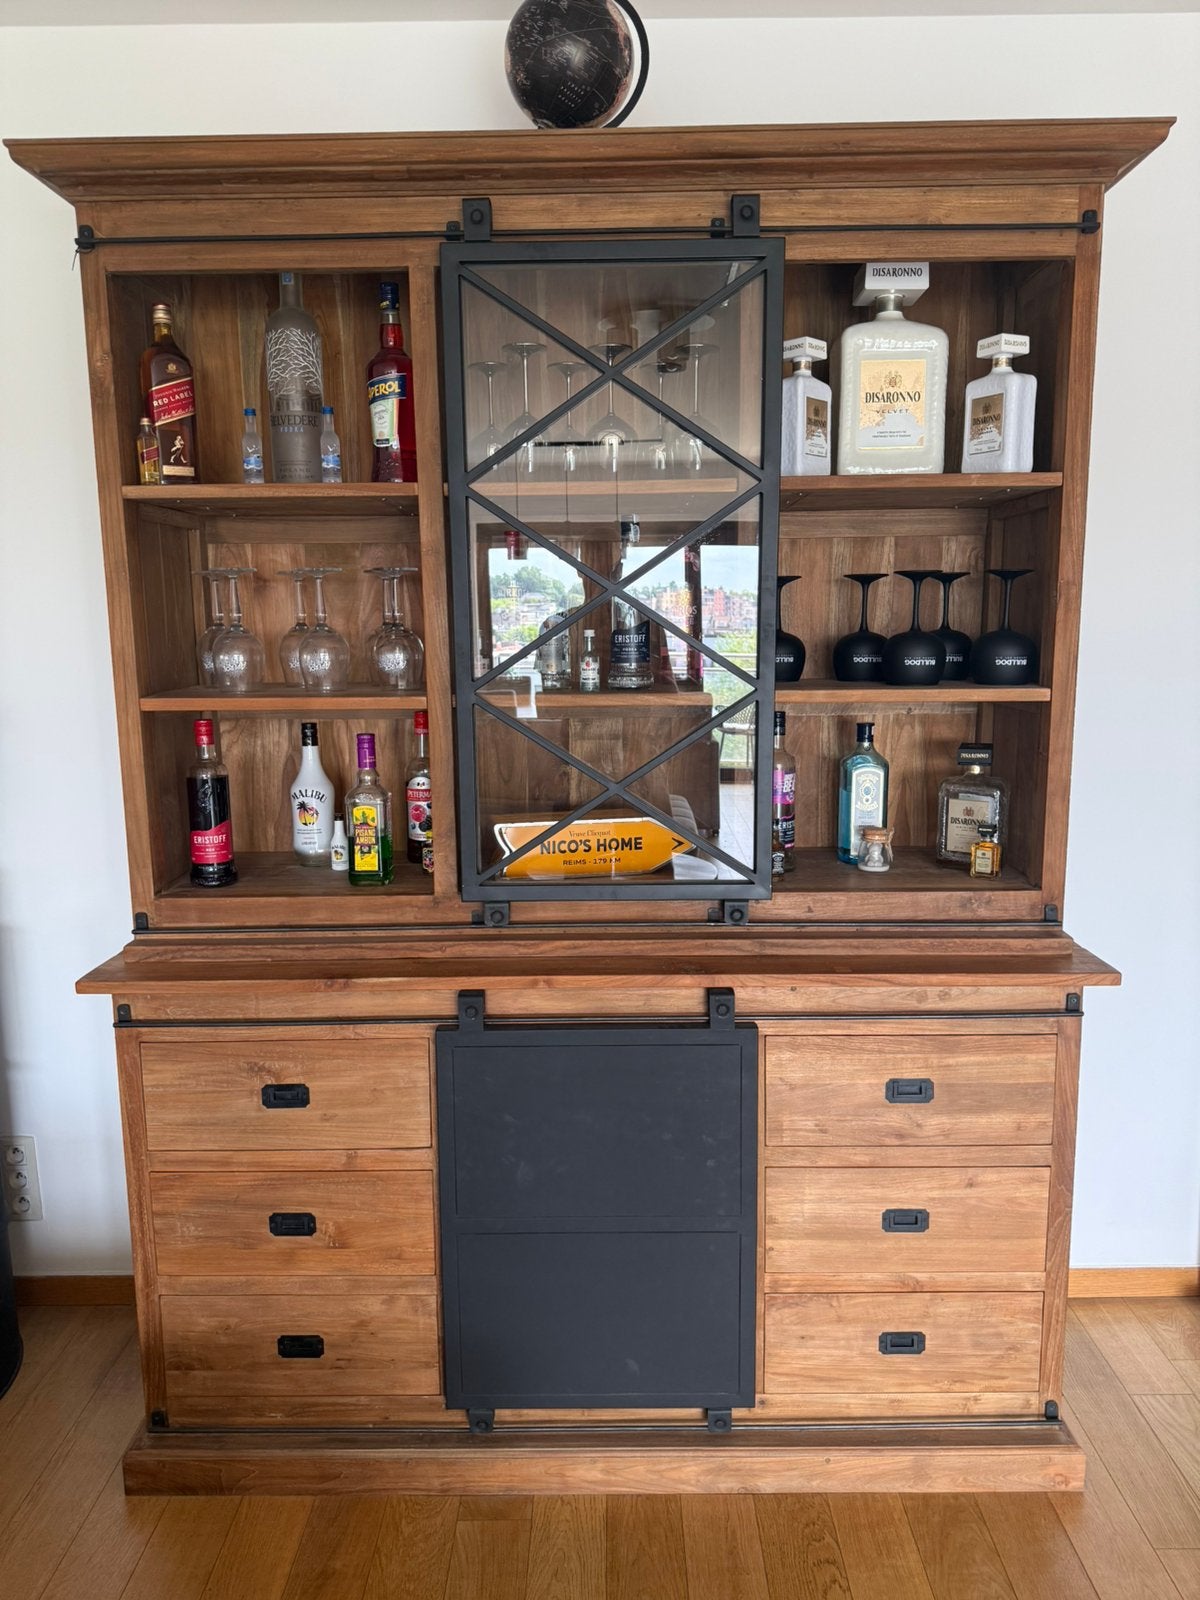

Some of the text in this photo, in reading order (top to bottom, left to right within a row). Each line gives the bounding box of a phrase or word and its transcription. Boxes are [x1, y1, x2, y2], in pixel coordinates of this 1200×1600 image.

[871, 267, 923, 277] DISARONNO
[153, 399, 170, 408] RED
[170, 391, 193, 403] LABEL
[865, 390, 922, 405] DISARONNO
[614, 634, 647, 643] ERISTOFF
[291, 788, 328, 804] MALIBU
[950, 816, 987, 826] DISARONNO
[193, 834, 227, 844] ERISTOFF
[540, 836, 643, 855] NICO'S HOME
